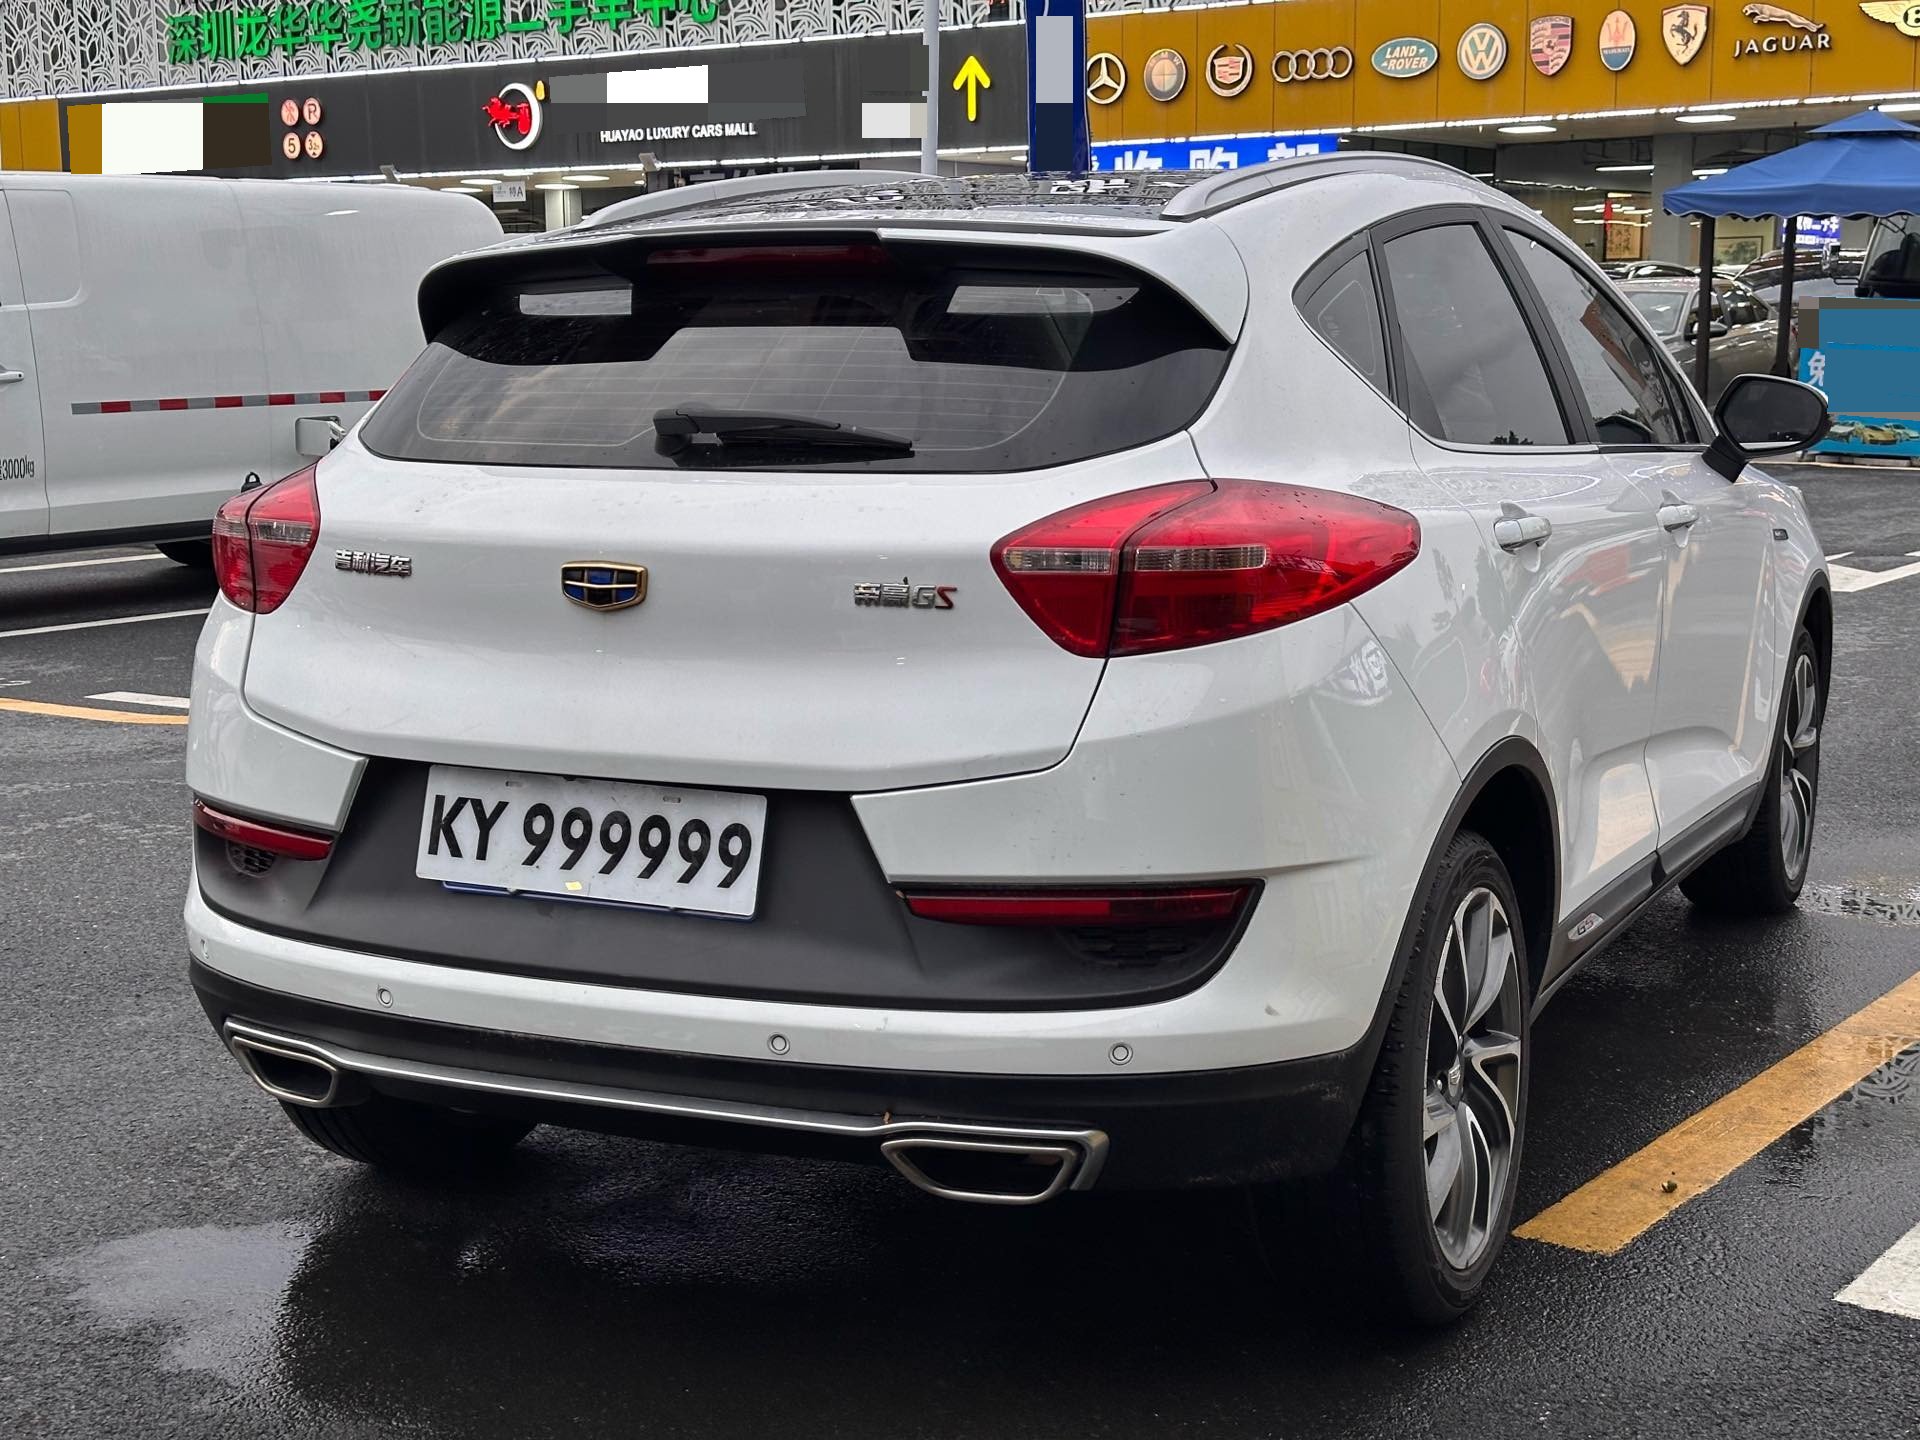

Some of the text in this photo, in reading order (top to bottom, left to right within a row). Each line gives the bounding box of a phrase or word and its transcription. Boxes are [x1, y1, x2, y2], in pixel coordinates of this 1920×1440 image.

[1385, 46, 1417, 59] LAND
[1734, 33, 1830, 57] JAGUAR
[1387, 57, 1428, 70] ROVER
[600, 122, 757, 143] HUAYAO LUXURY CARS MALL
[288, 137, 296, 154] 5
[0, 454, 34, 480] 3000kg
[334, 549, 412, 578] 吉利汽车
[427, 794, 752, 888] KY 999999
